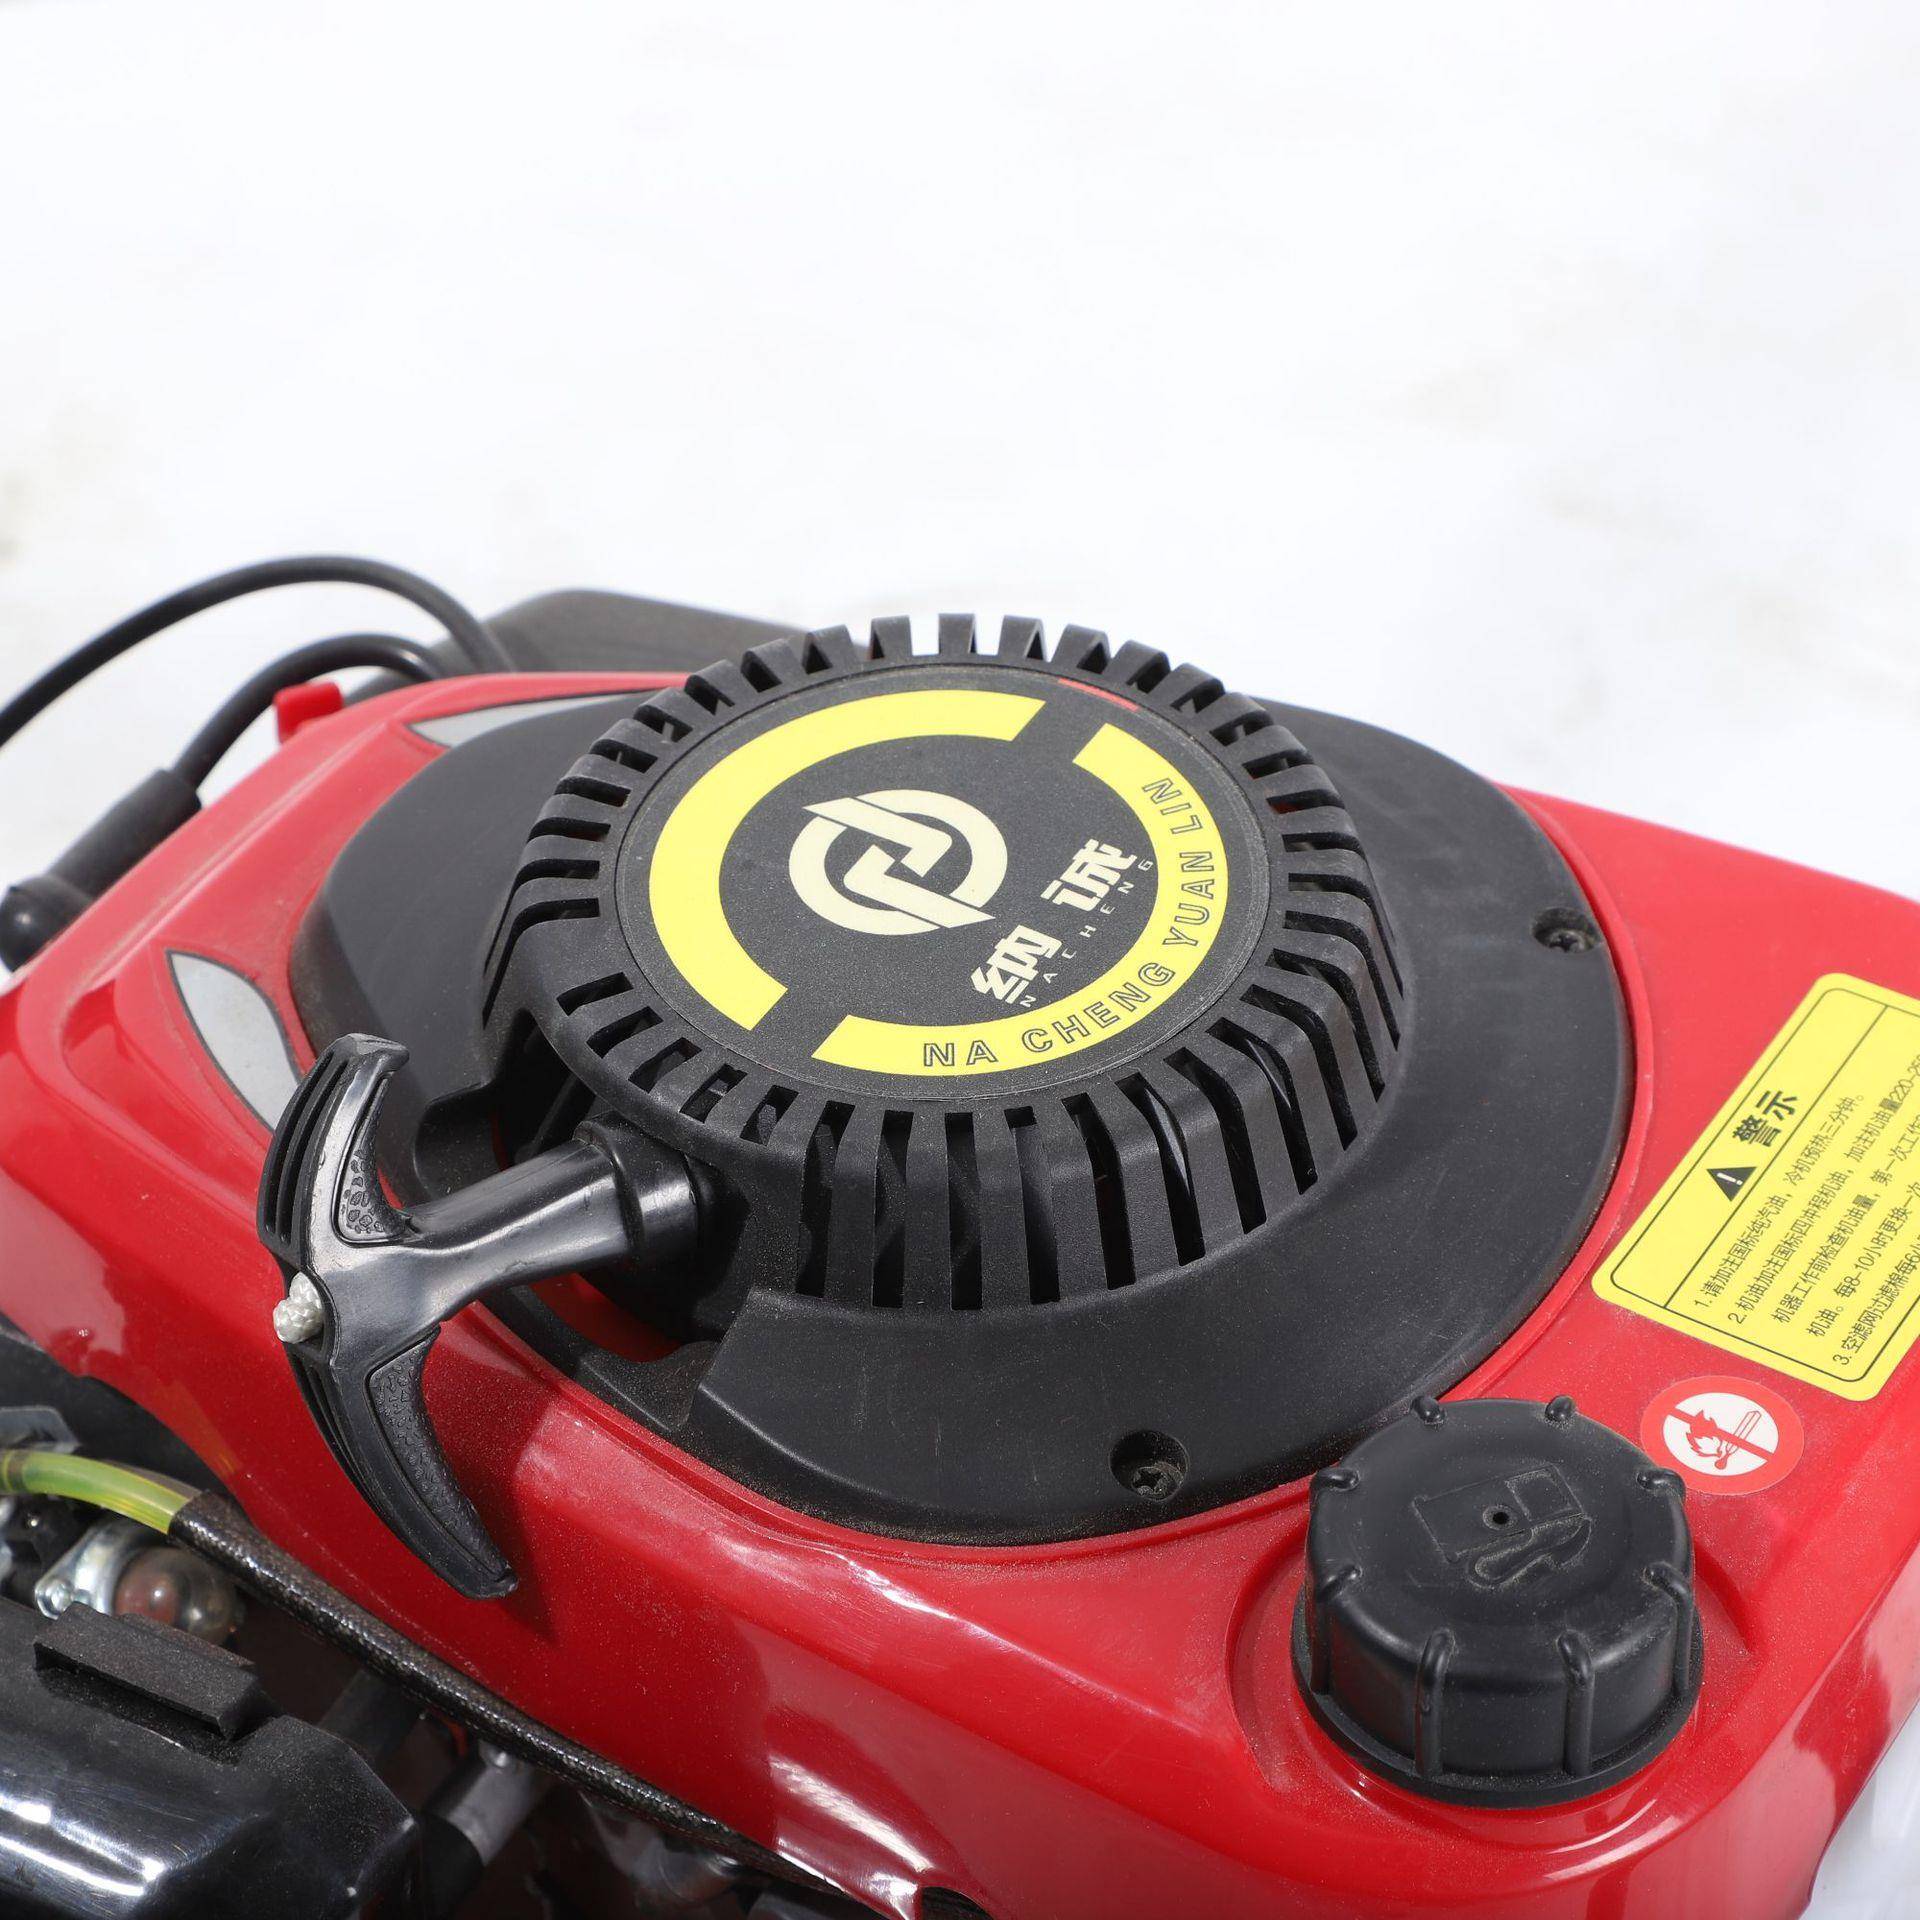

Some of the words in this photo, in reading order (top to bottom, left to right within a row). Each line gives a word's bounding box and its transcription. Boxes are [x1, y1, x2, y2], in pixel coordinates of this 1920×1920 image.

[1142, 778, 1203, 834] LIN
[1163, 850, 1214, 947] YUAN
[1021, 962, 1175, 1053] CHENG
[923, 1040, 998, 1067] NA
[1732, 1090, 1798, 1148] 警示
